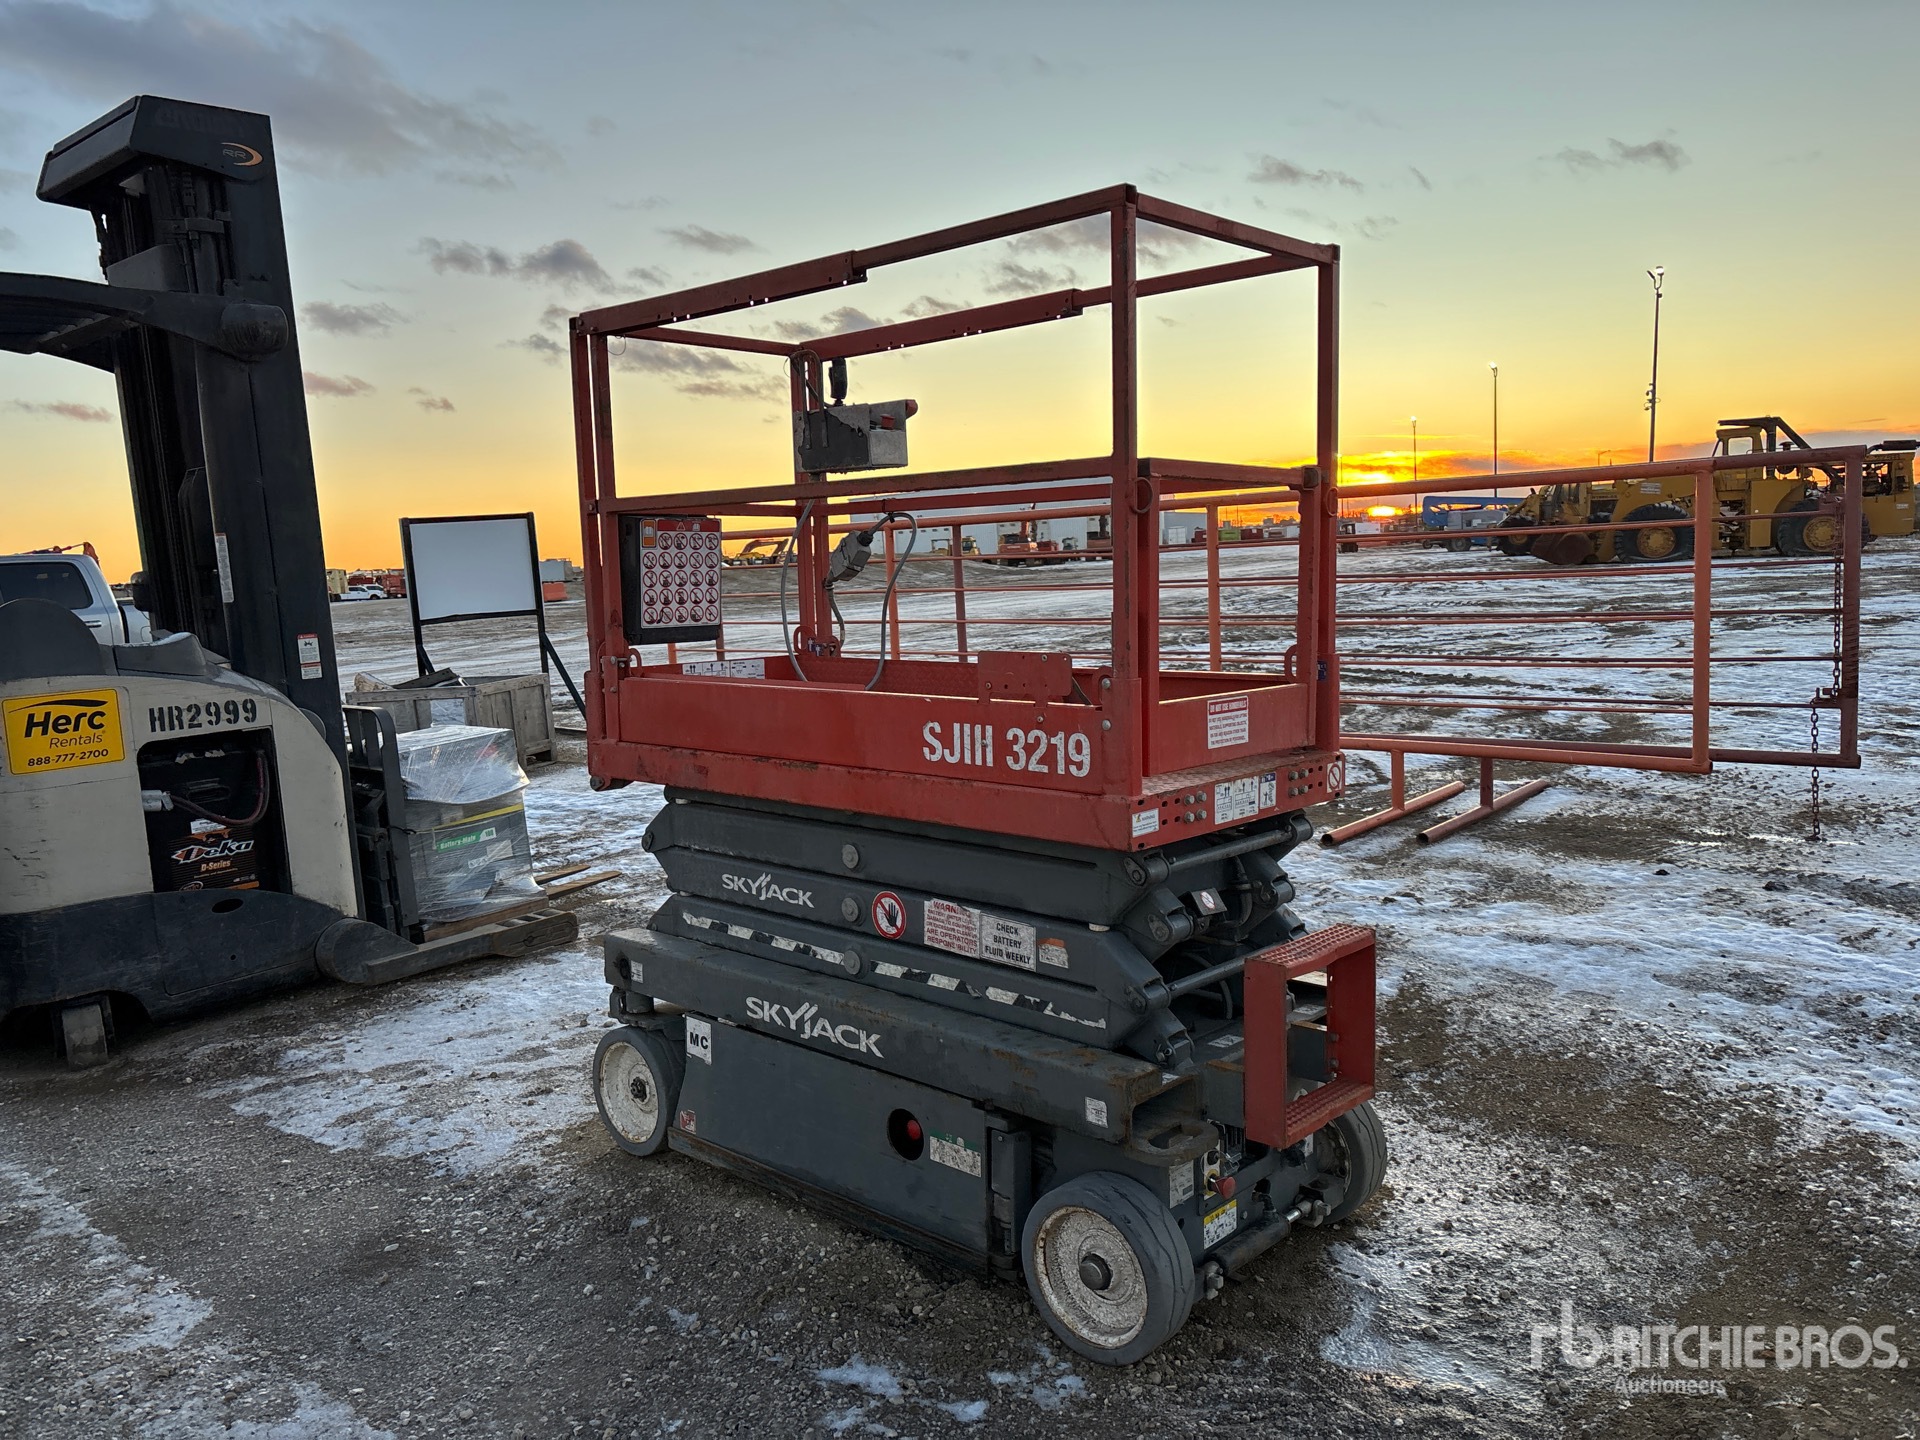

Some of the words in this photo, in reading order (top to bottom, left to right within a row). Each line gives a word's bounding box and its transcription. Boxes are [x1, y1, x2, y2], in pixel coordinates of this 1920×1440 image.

[24, 710, 106, 738] Herc
[148, 698, 257, 733] HR2999
[49, 733, 103, 749] Rentals
[27, 748, 109, 767] 888-777-2700
[1005, 727, 1091, 778] 3219
[171, 839, 255, 864] Deka
[201, 860, 231, 872] D-Series
[721, 872, 815, 909] SKYJACK
[927, 927, 939, 936] ARE
[939, 930, 978, 947] OPERATORS
[996, 922, 1018, 936] CHECK
[993, 934, 1022, 949] BATTERY
[985, 945, 1004, 958] FLUID
[1004, 950, 1031, 965] WEEKLY
[745, 996, 885, 1059] SKYJACK
[689, 1031, 709, 1050] MC
